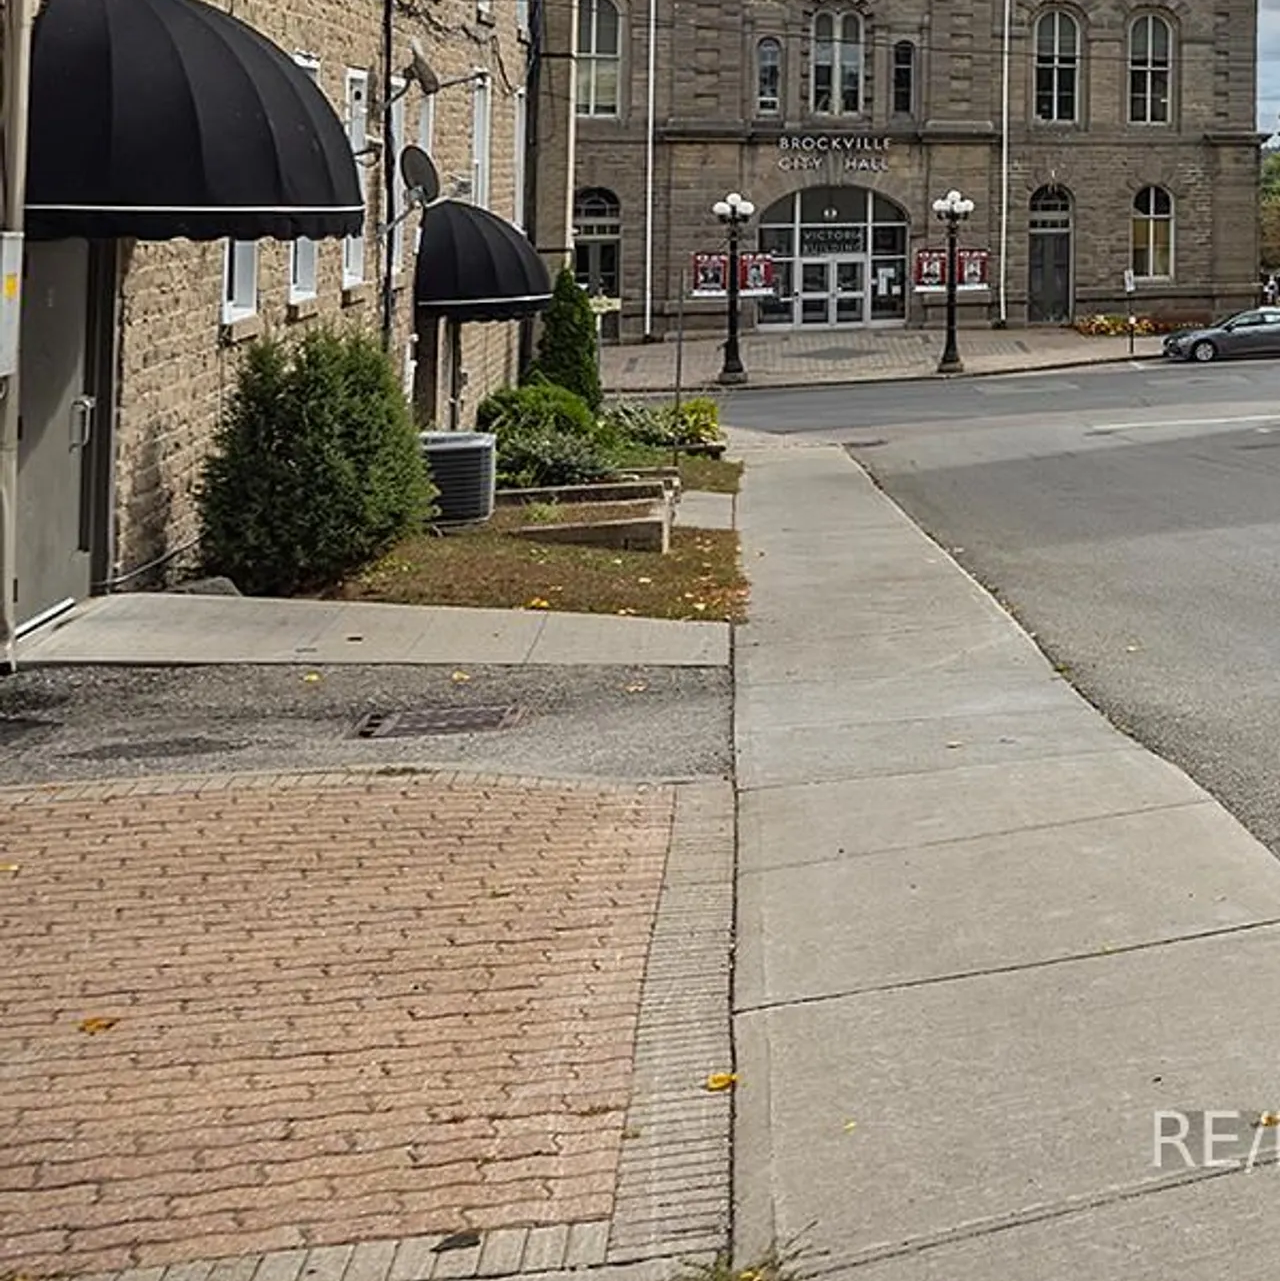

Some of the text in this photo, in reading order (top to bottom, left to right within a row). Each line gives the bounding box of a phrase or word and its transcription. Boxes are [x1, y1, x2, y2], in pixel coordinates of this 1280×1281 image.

[779, 136, 892, 151] BROCKVILLE
[778, 157, 889, 171] CITY HALL
